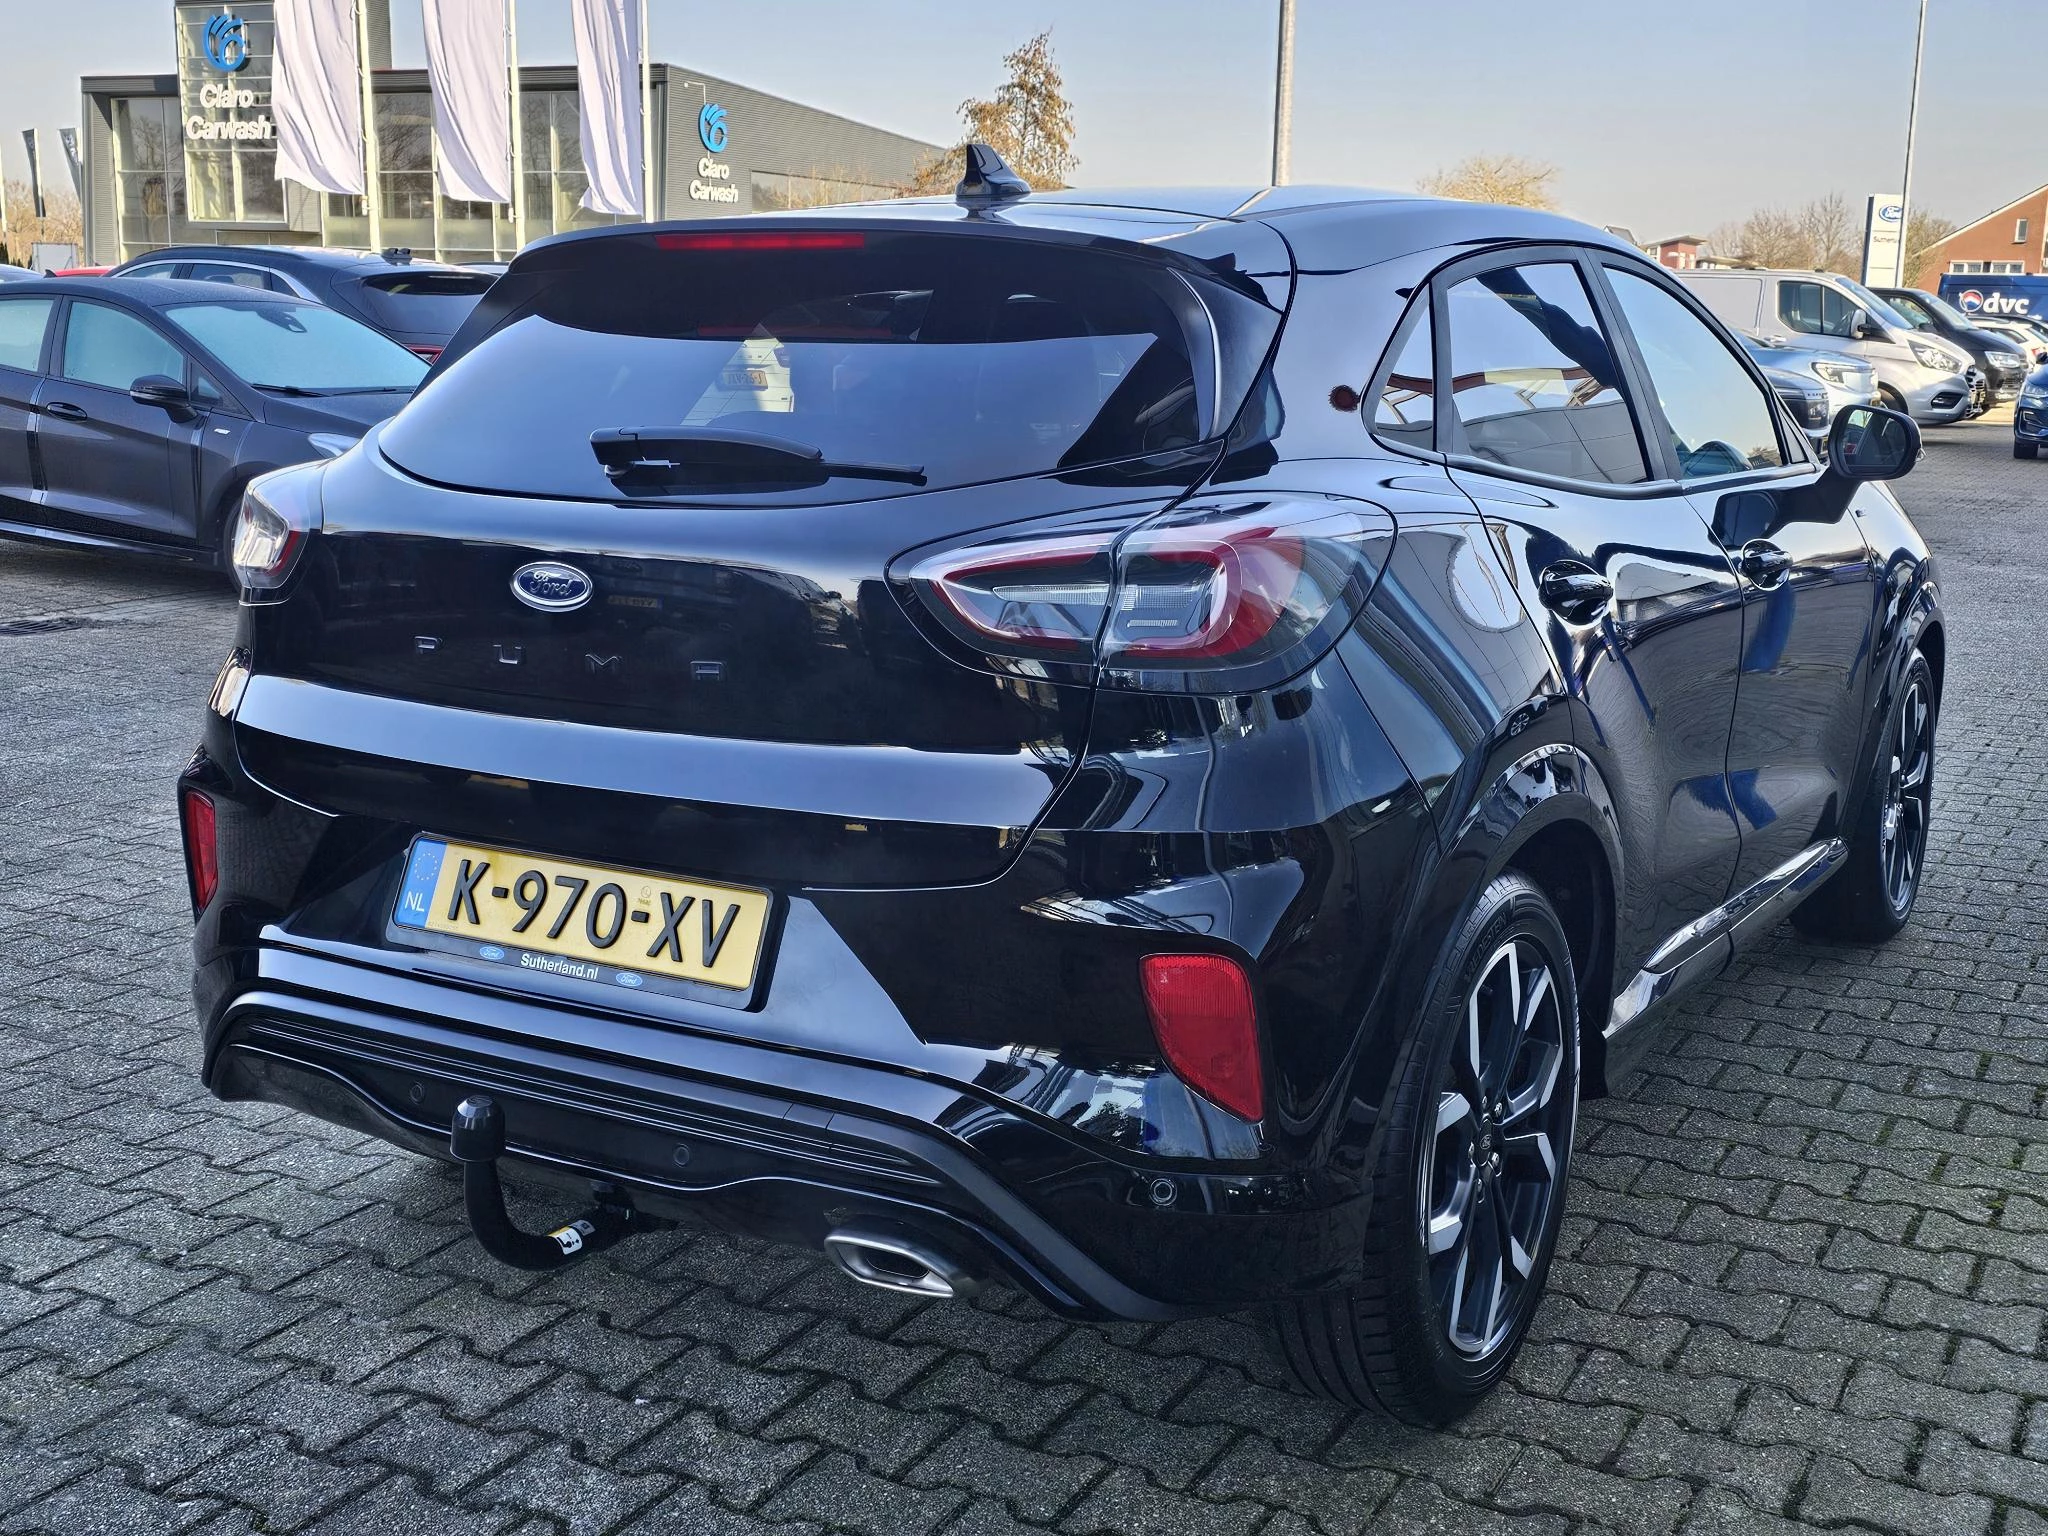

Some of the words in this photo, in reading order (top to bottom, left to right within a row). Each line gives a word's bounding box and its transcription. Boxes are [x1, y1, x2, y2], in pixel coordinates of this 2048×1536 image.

[200, 83, 254, 109] Claro
[186, 114, 271, 140] Carwash
[698, 157, 730, 180] Claro
[689, 179, 739, 203] Carwash
[1983, 292, 2030, 315] dvc
[518, 568, 575, 598] Ford
[404, 890, 425, 913] NL
[447, 858, 741, 969] K-970-XV
[520, 953, 599, 980] Sutherland.nl
